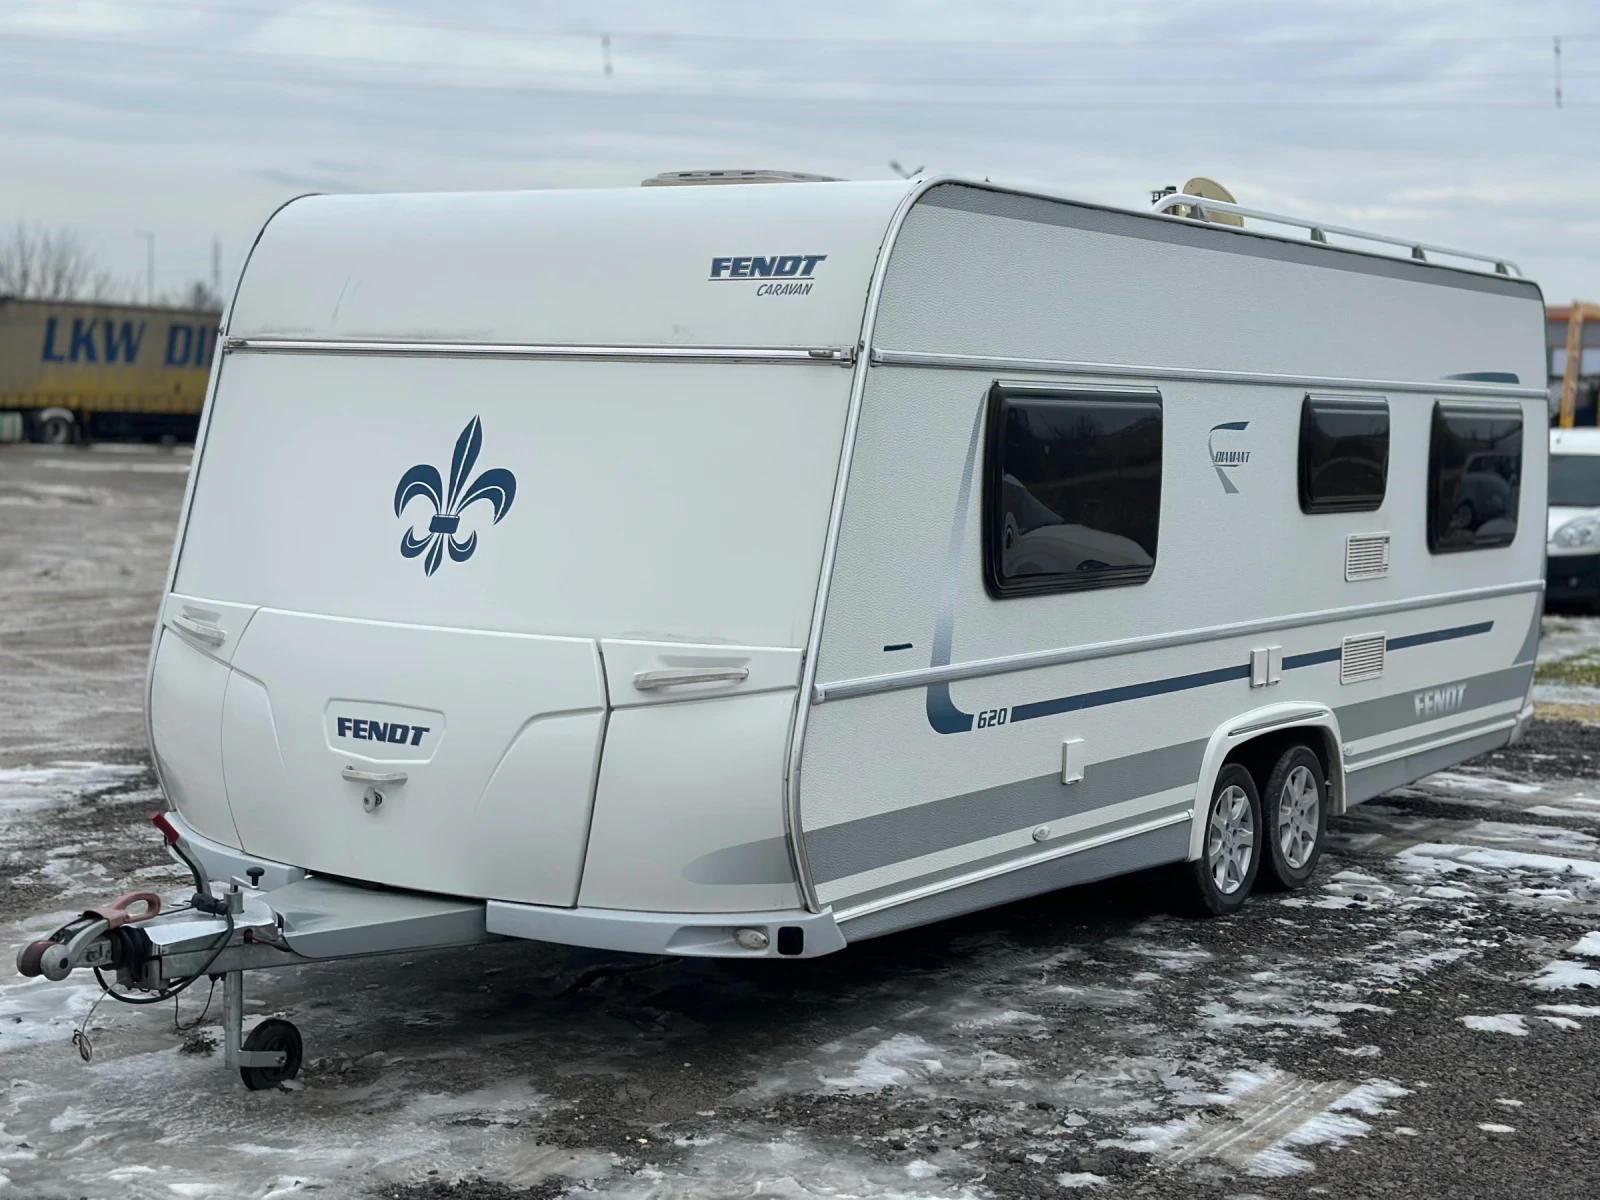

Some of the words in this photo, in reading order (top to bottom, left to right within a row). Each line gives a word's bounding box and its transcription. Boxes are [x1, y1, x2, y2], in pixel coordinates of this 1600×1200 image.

[710, 255, 828, 277] FENDT
[756, 283, 814, 296] CARAVAN
[41, 317, 146, 363] LKW
[1214, 451, 1251, 463] DIAMANT
[1413, 682, 1467, 718] FENDT
[977, 707, 1007, 729] 620
[337, 716, 431, 746] FENDT
